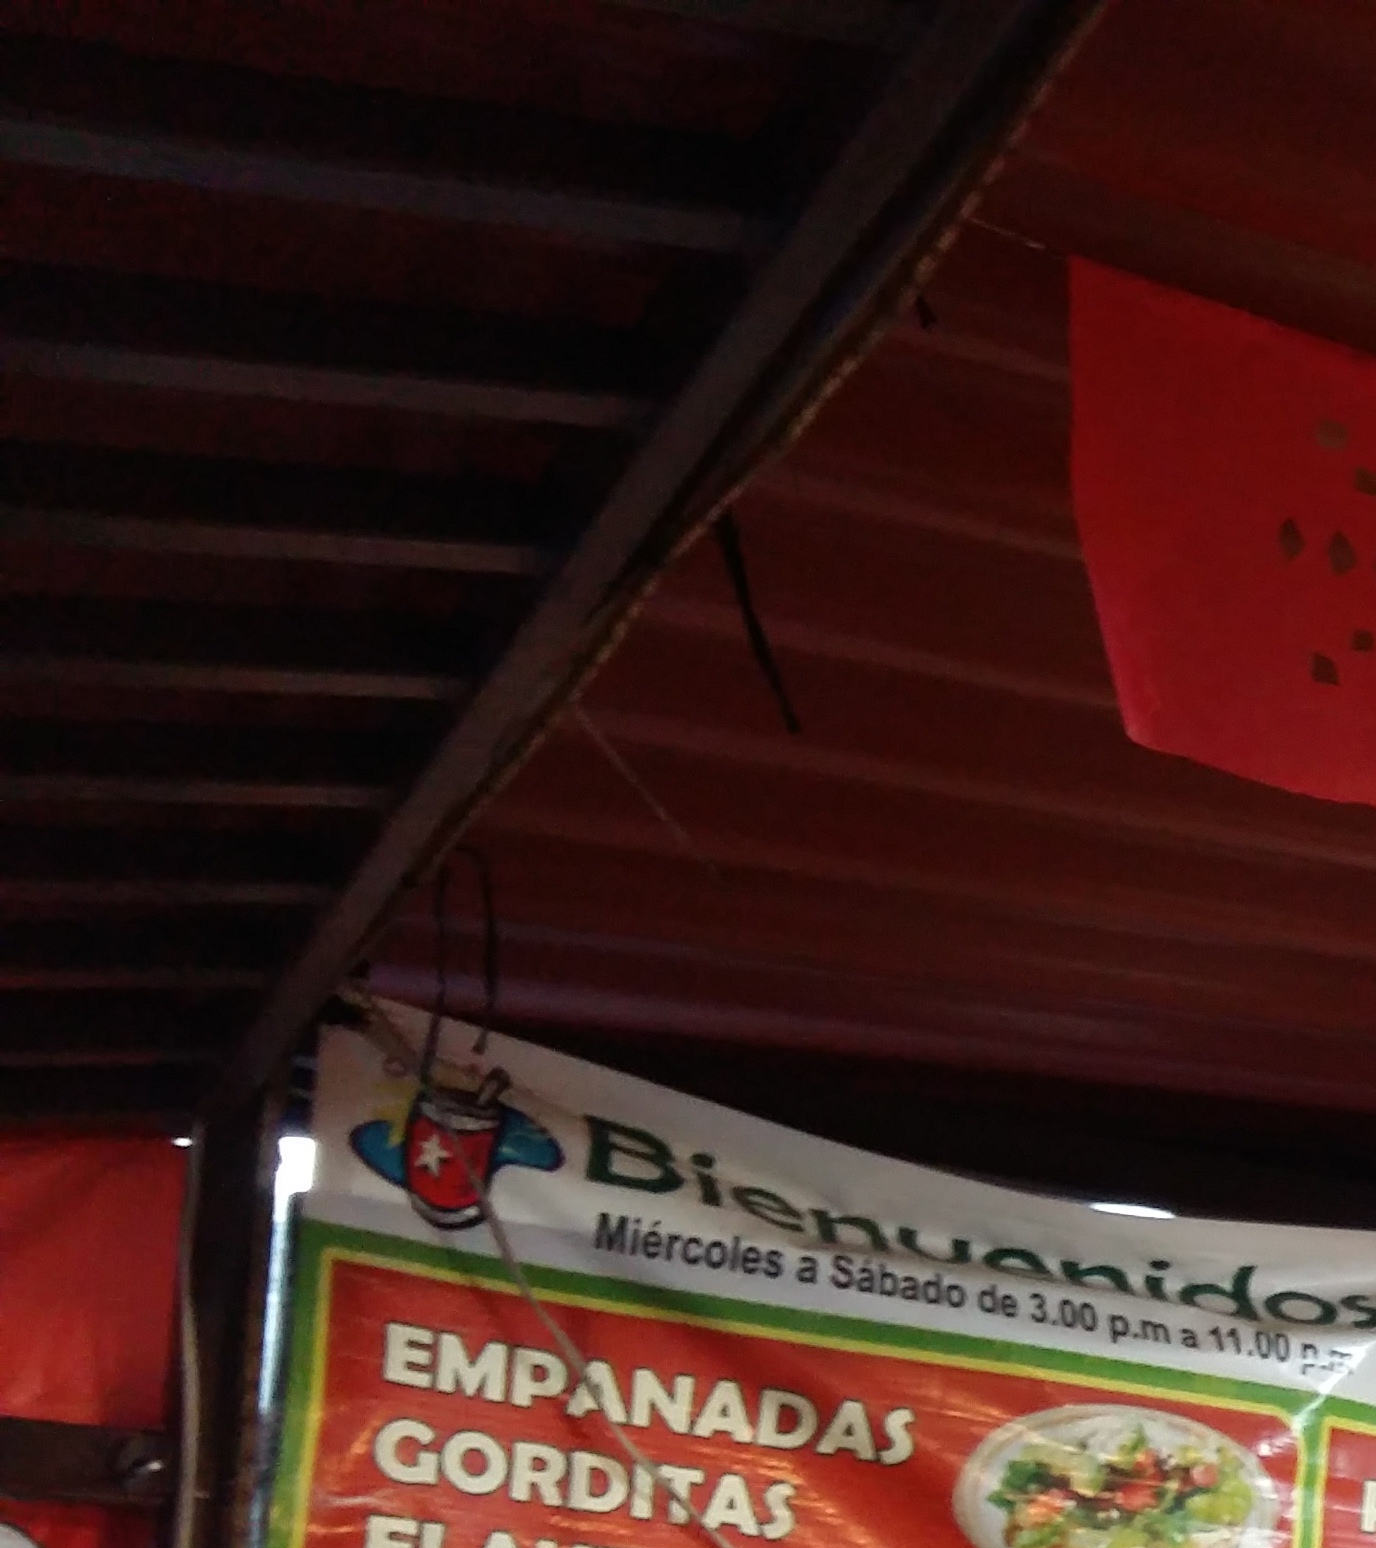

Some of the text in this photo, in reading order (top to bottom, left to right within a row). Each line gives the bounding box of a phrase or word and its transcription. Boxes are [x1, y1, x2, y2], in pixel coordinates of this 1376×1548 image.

[594, 1211, 784, 1279] Miércoles
[796, 1255, 819, 1284] a
[830, 1253, 966, 1309] Sábado
[977, 1276, 1019, 1318] de
[1030, 1292, 1098, 1332] 3.00
[1181, 1327, 1200, 1349] a
[1210, 1326, 1291, 1363] 11.00
[383, 1322, 916, 1466] EMPANADAS
[373, 1417, 797, 1540] GORDITAS
